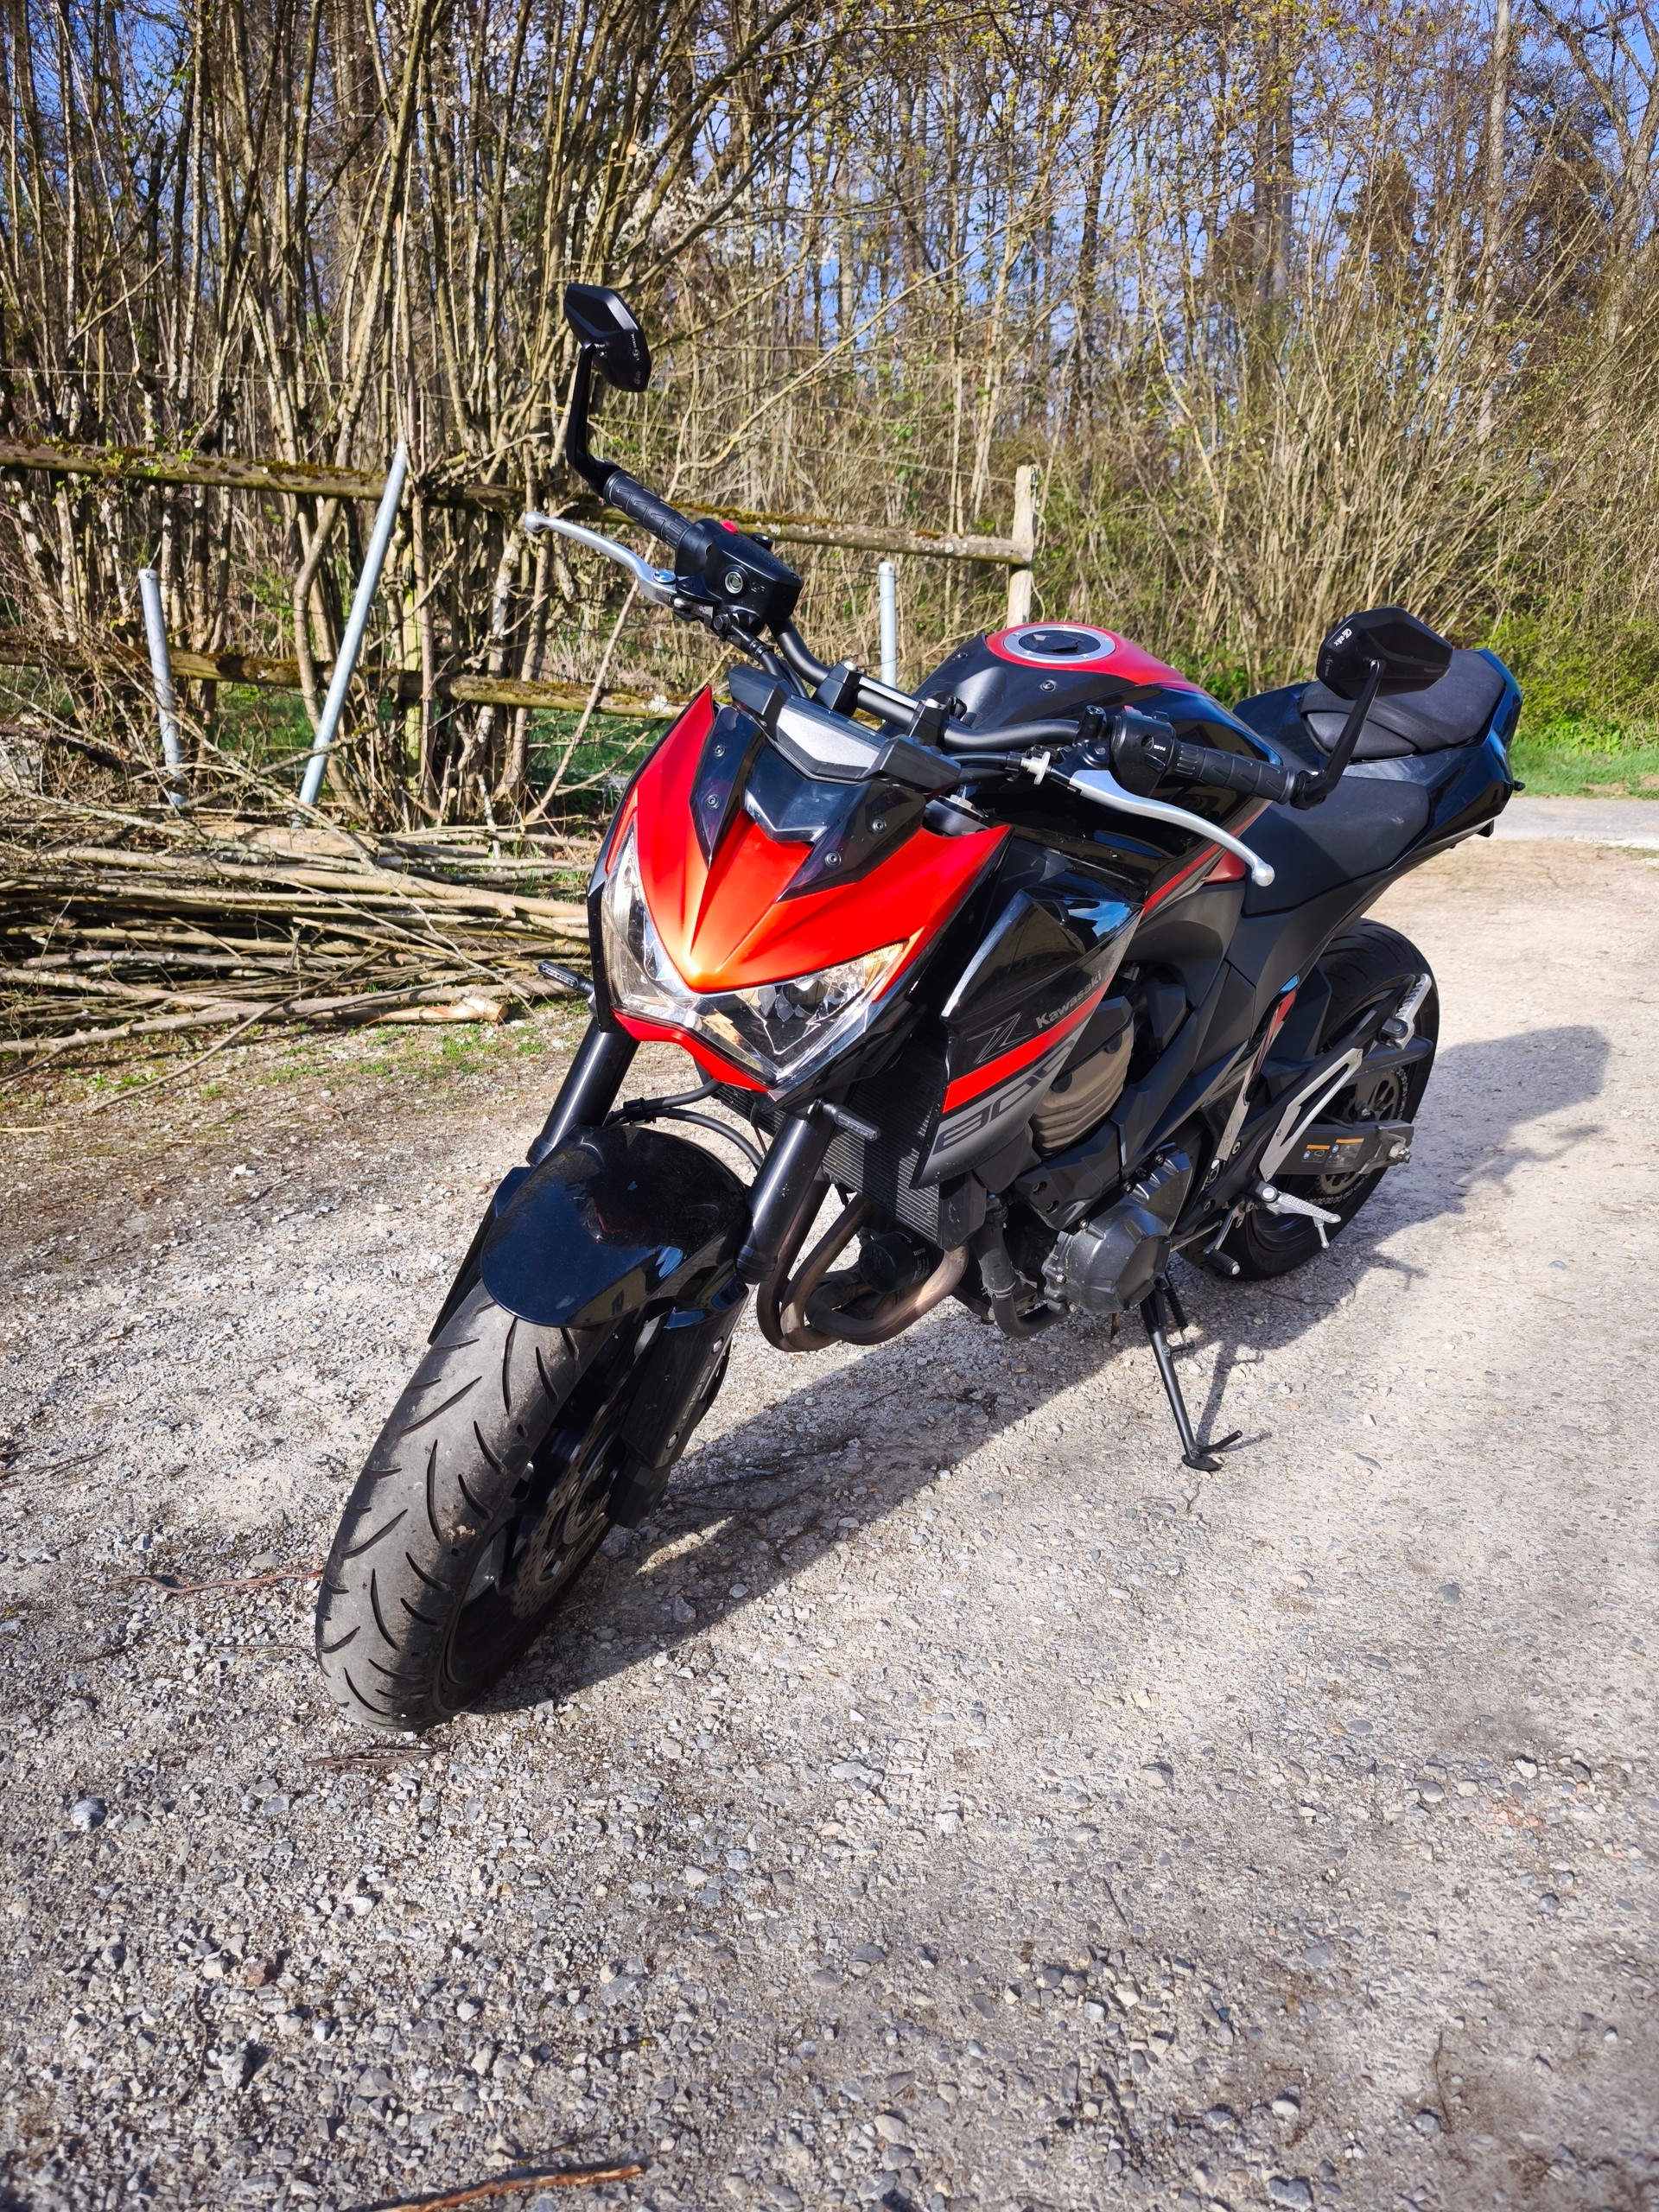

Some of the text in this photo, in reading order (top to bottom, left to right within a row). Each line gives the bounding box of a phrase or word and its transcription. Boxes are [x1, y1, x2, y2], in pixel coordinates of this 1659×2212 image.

[1036, 969, 1102, 1029] Kawasaki
[967, 1011, 1033, 1065] Z
[932, 1039, 1076, 1156] 800
